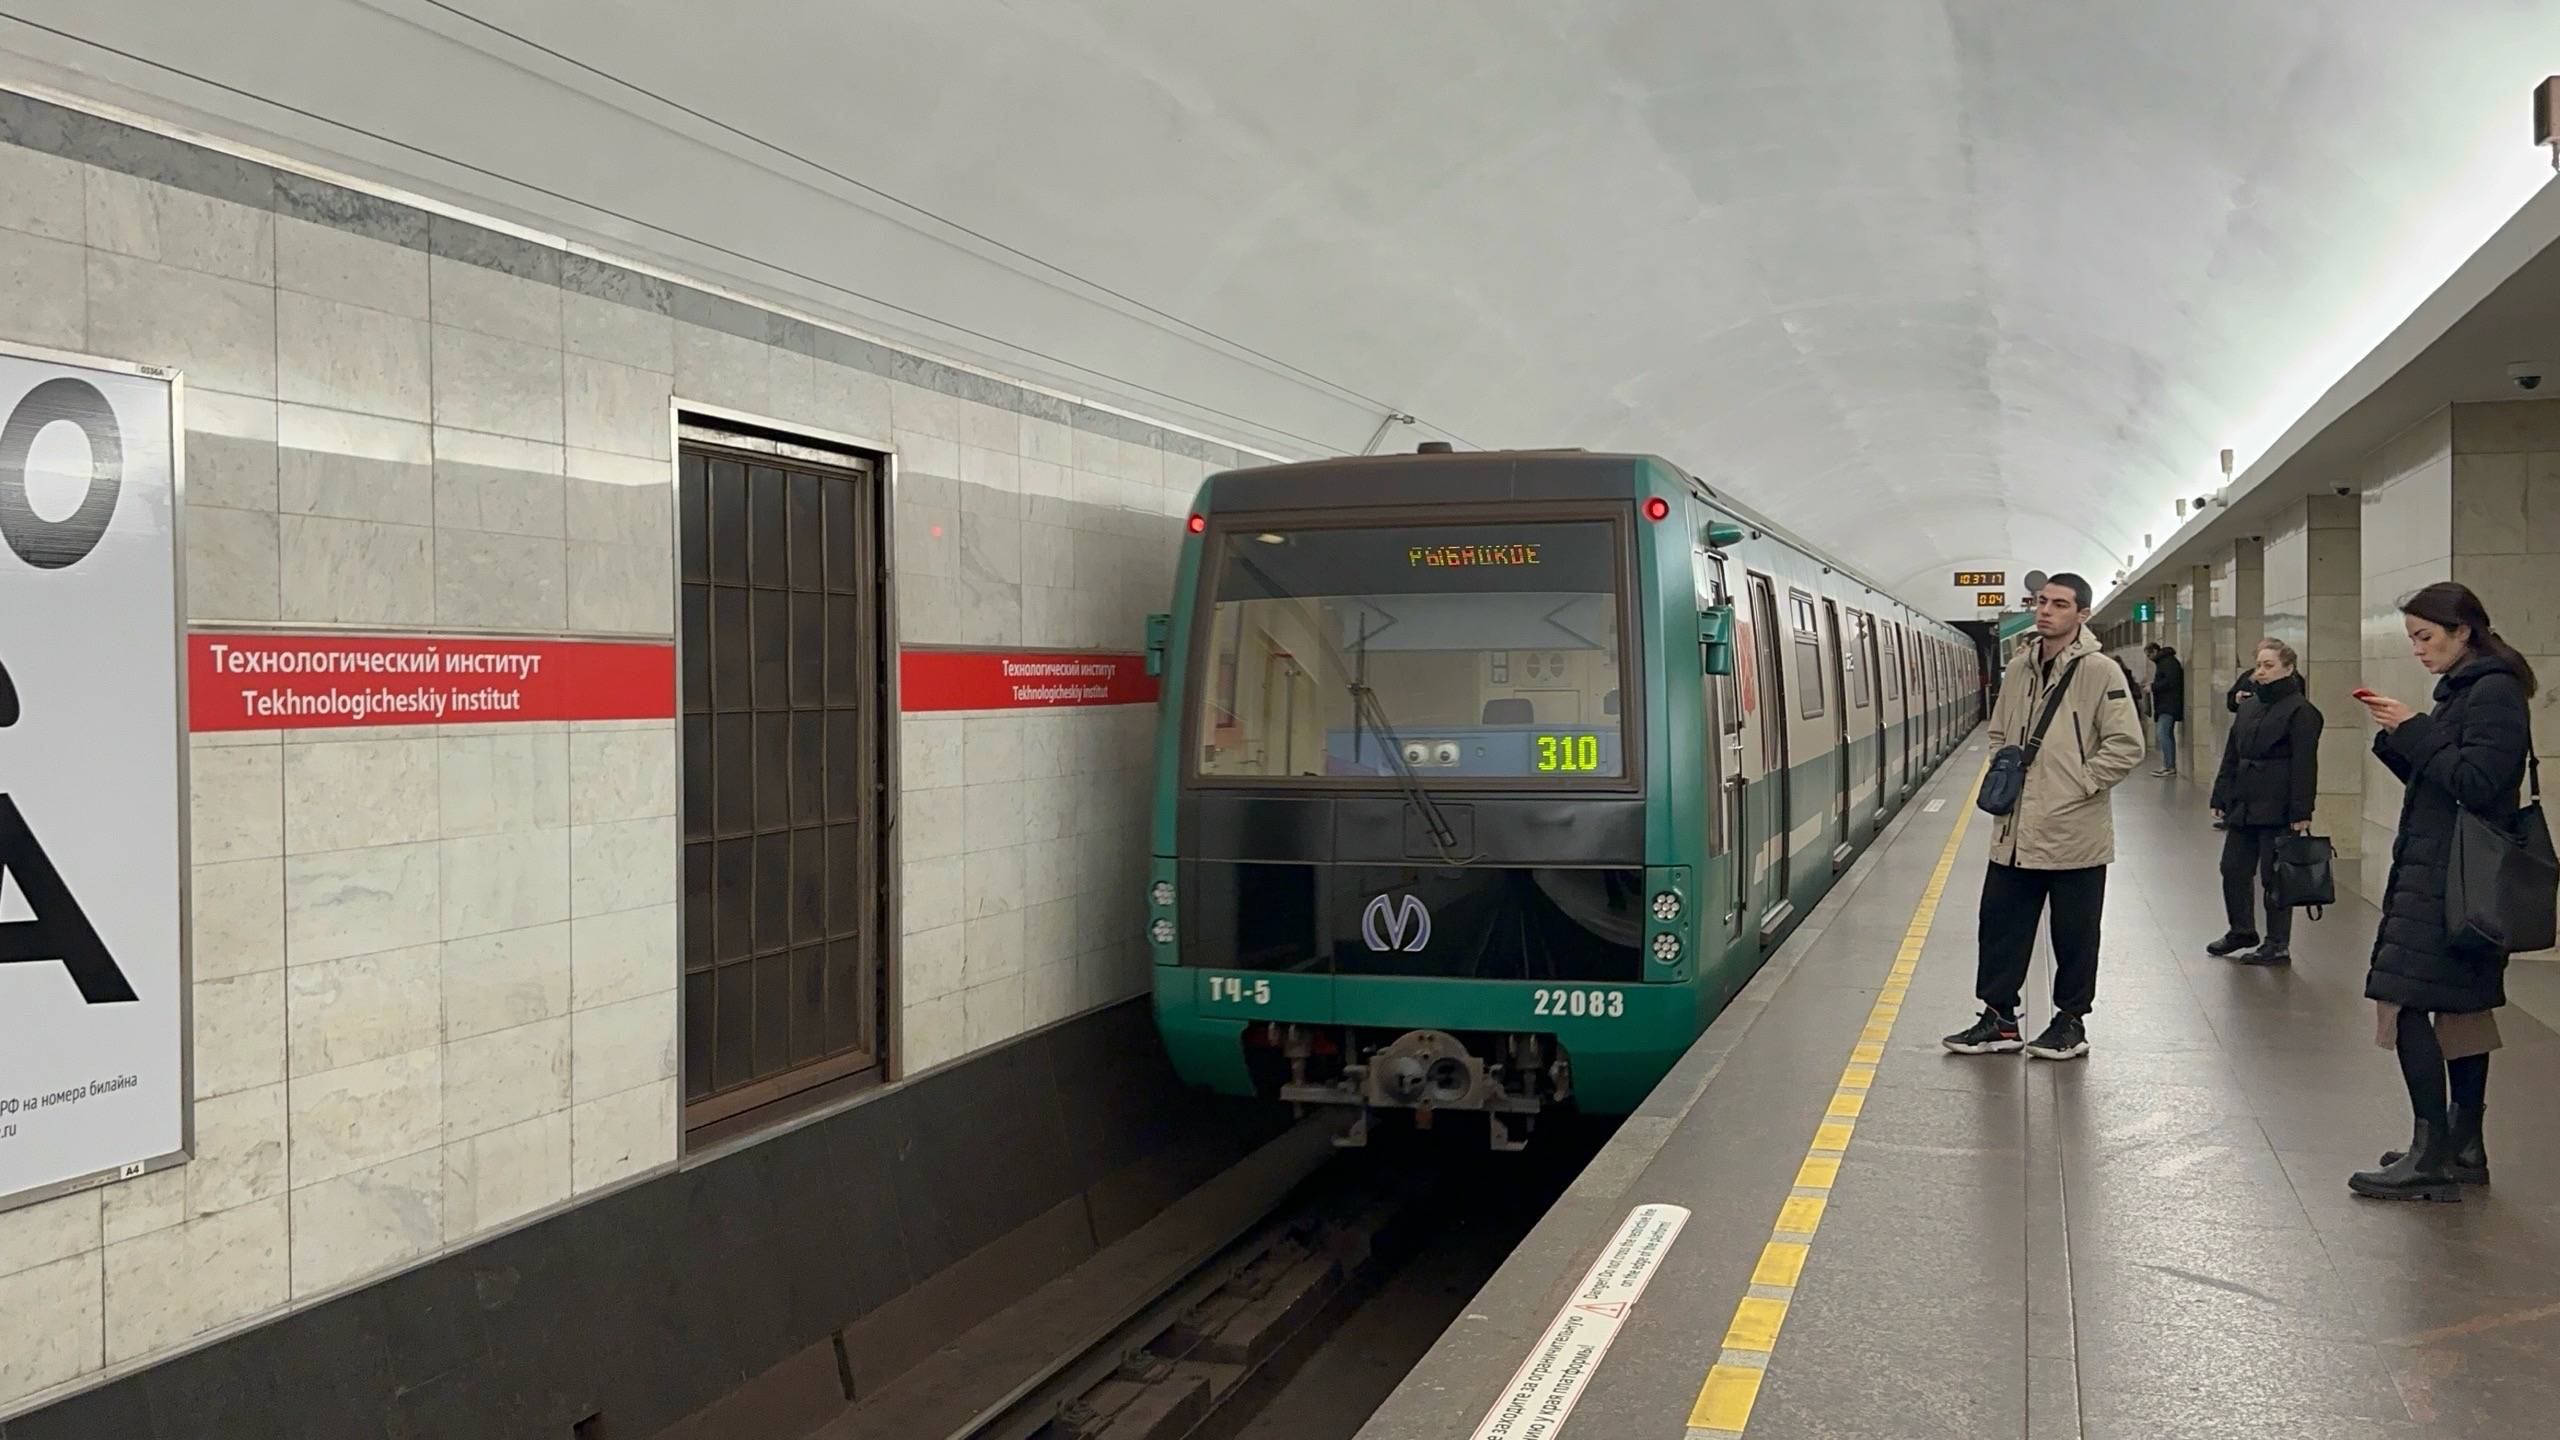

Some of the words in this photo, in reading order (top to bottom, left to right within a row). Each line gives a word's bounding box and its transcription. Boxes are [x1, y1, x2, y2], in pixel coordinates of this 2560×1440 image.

[1409, 543, 1541, 567] РЫБАЦКОЕ
[210, 644, 440, 674] Технологический
[446, 653, 542, 680] институт
[1002, 659, 1080, 677] Технологический
[1081, 663, 1116, 680] институт
[242, 687, 447, 720] Tekhnologicheskiy
[451, 687, 521, 711] institut
[1012, 684, 1083, 703] Tekhnologicheskiy
[1538, 736, 1598, 771] 310
[1209, 976, 1272, 1005] ТЧ-5
[1533, 989, 1625, 1018] 22083
[23, 1097, 37, 1111] на
[41, 1085, 86, 1108] номера
[89, 1074, 138, 1096] билайна
[1528, 1316, 1583, 1381] ограничительную
[1519, 1382, 1539, 1393] за
[1492, 1393, 1531, 1434] заходите
[1539, 1395, 1564, 1415] края
